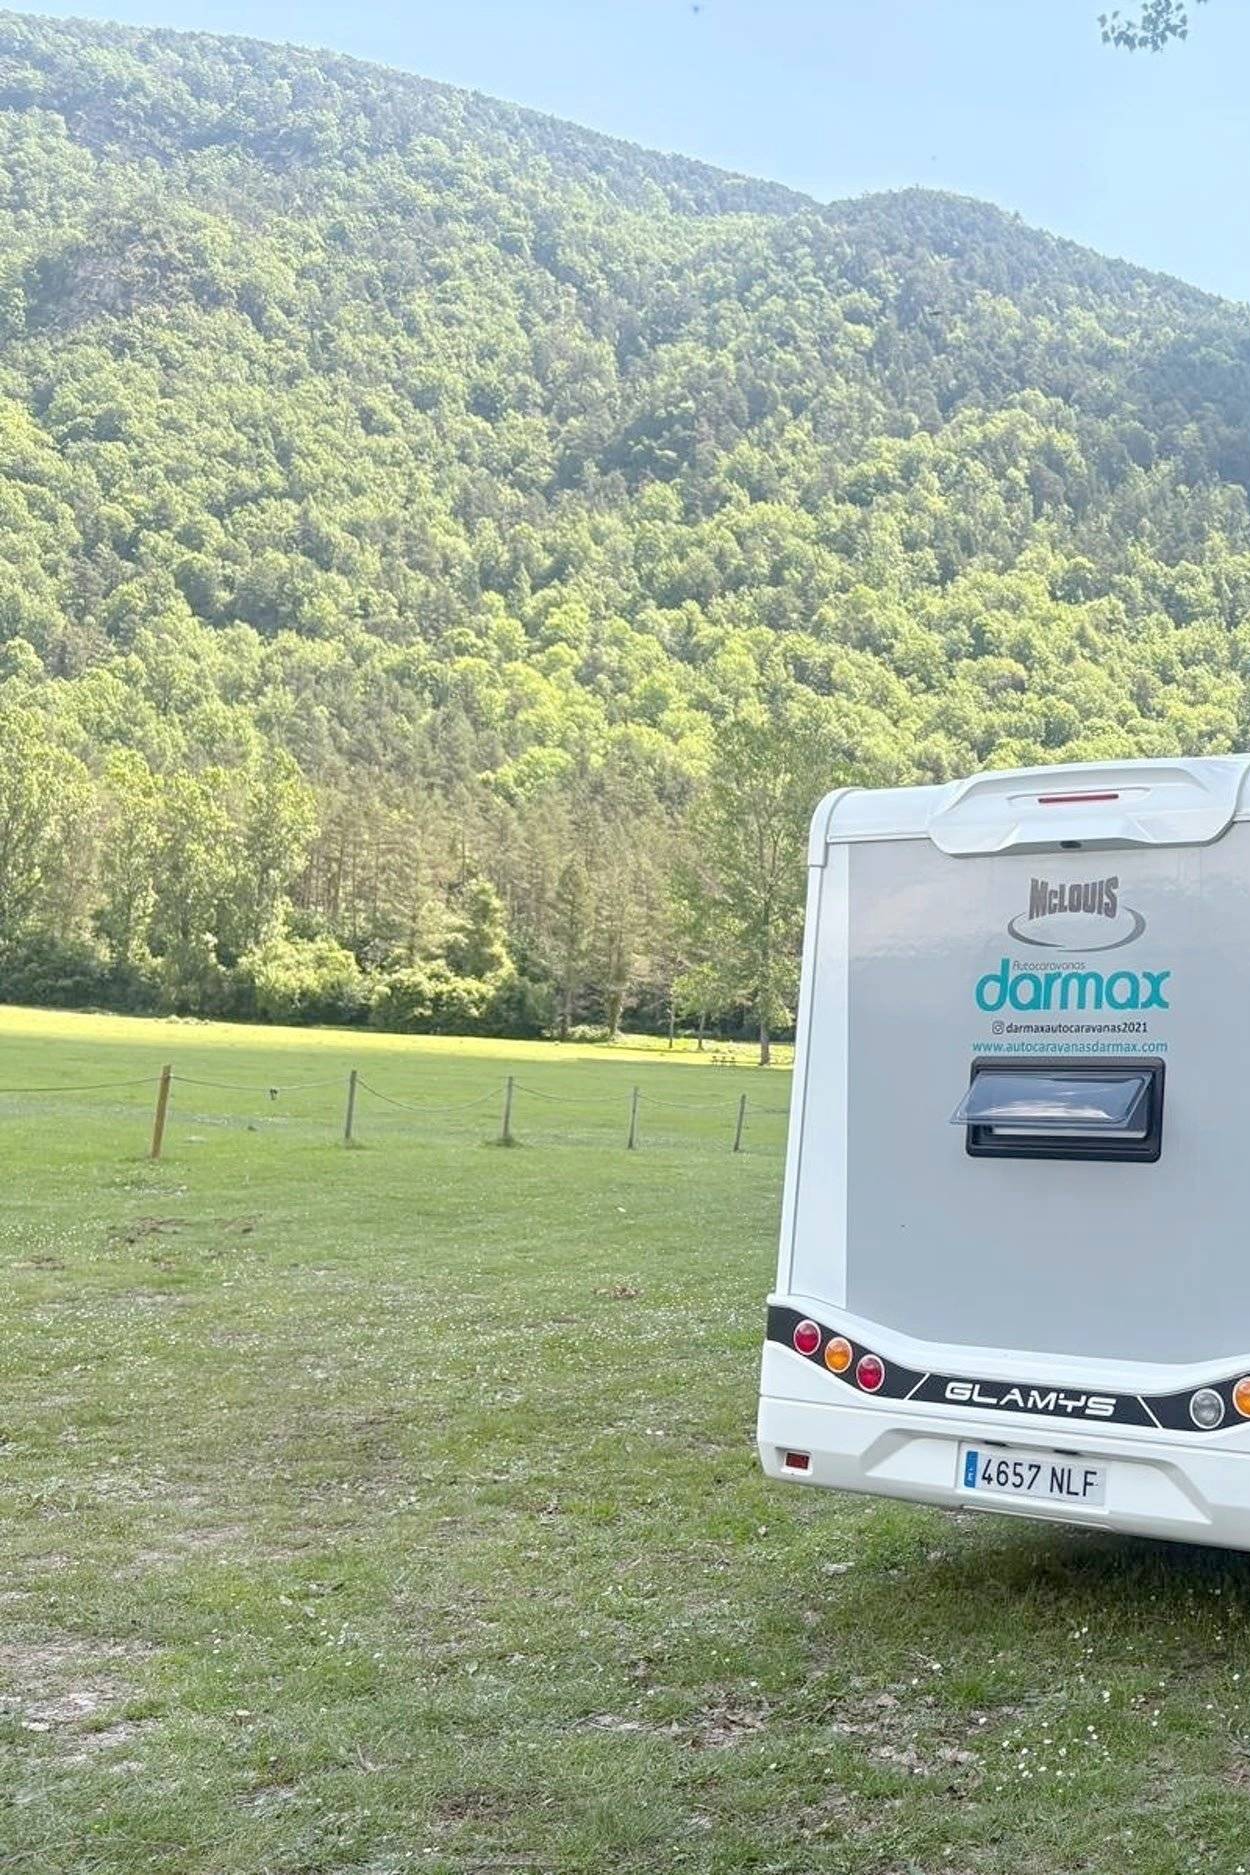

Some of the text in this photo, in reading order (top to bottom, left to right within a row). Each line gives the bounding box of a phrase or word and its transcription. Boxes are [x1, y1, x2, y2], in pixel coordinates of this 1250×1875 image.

[975, 958, 1171, 1012] darmax
[1006, 1021, 1148, 1034] darmaxautocaravanas2021
[972, 1041, 1168, 1053] www.autocaravanasdarmax.com
[945, 1382, 1116, 1417] GLAMYS
[981, 1459, 1097, 1497] 4657 NLF
